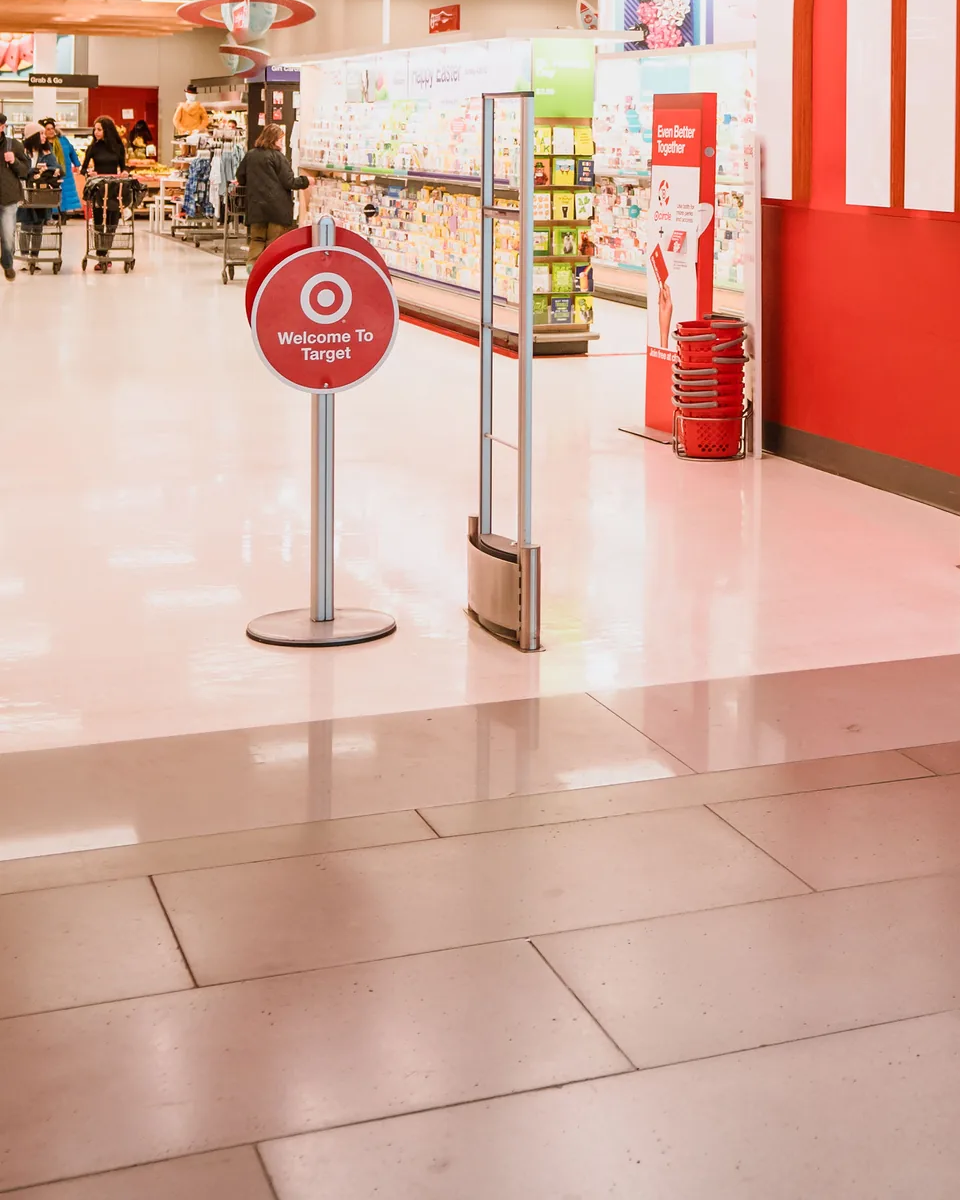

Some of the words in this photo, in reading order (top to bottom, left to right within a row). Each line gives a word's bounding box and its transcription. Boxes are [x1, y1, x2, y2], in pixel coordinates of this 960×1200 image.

[657, 125, 674, 138] Even
[674, 125, 696, 138] Better
[656, 140, 686, 156] Together
[277, 330, 351, 345] Welcome
[355, 328, 374, 343] To
[301, 346, 351, 363] Target
